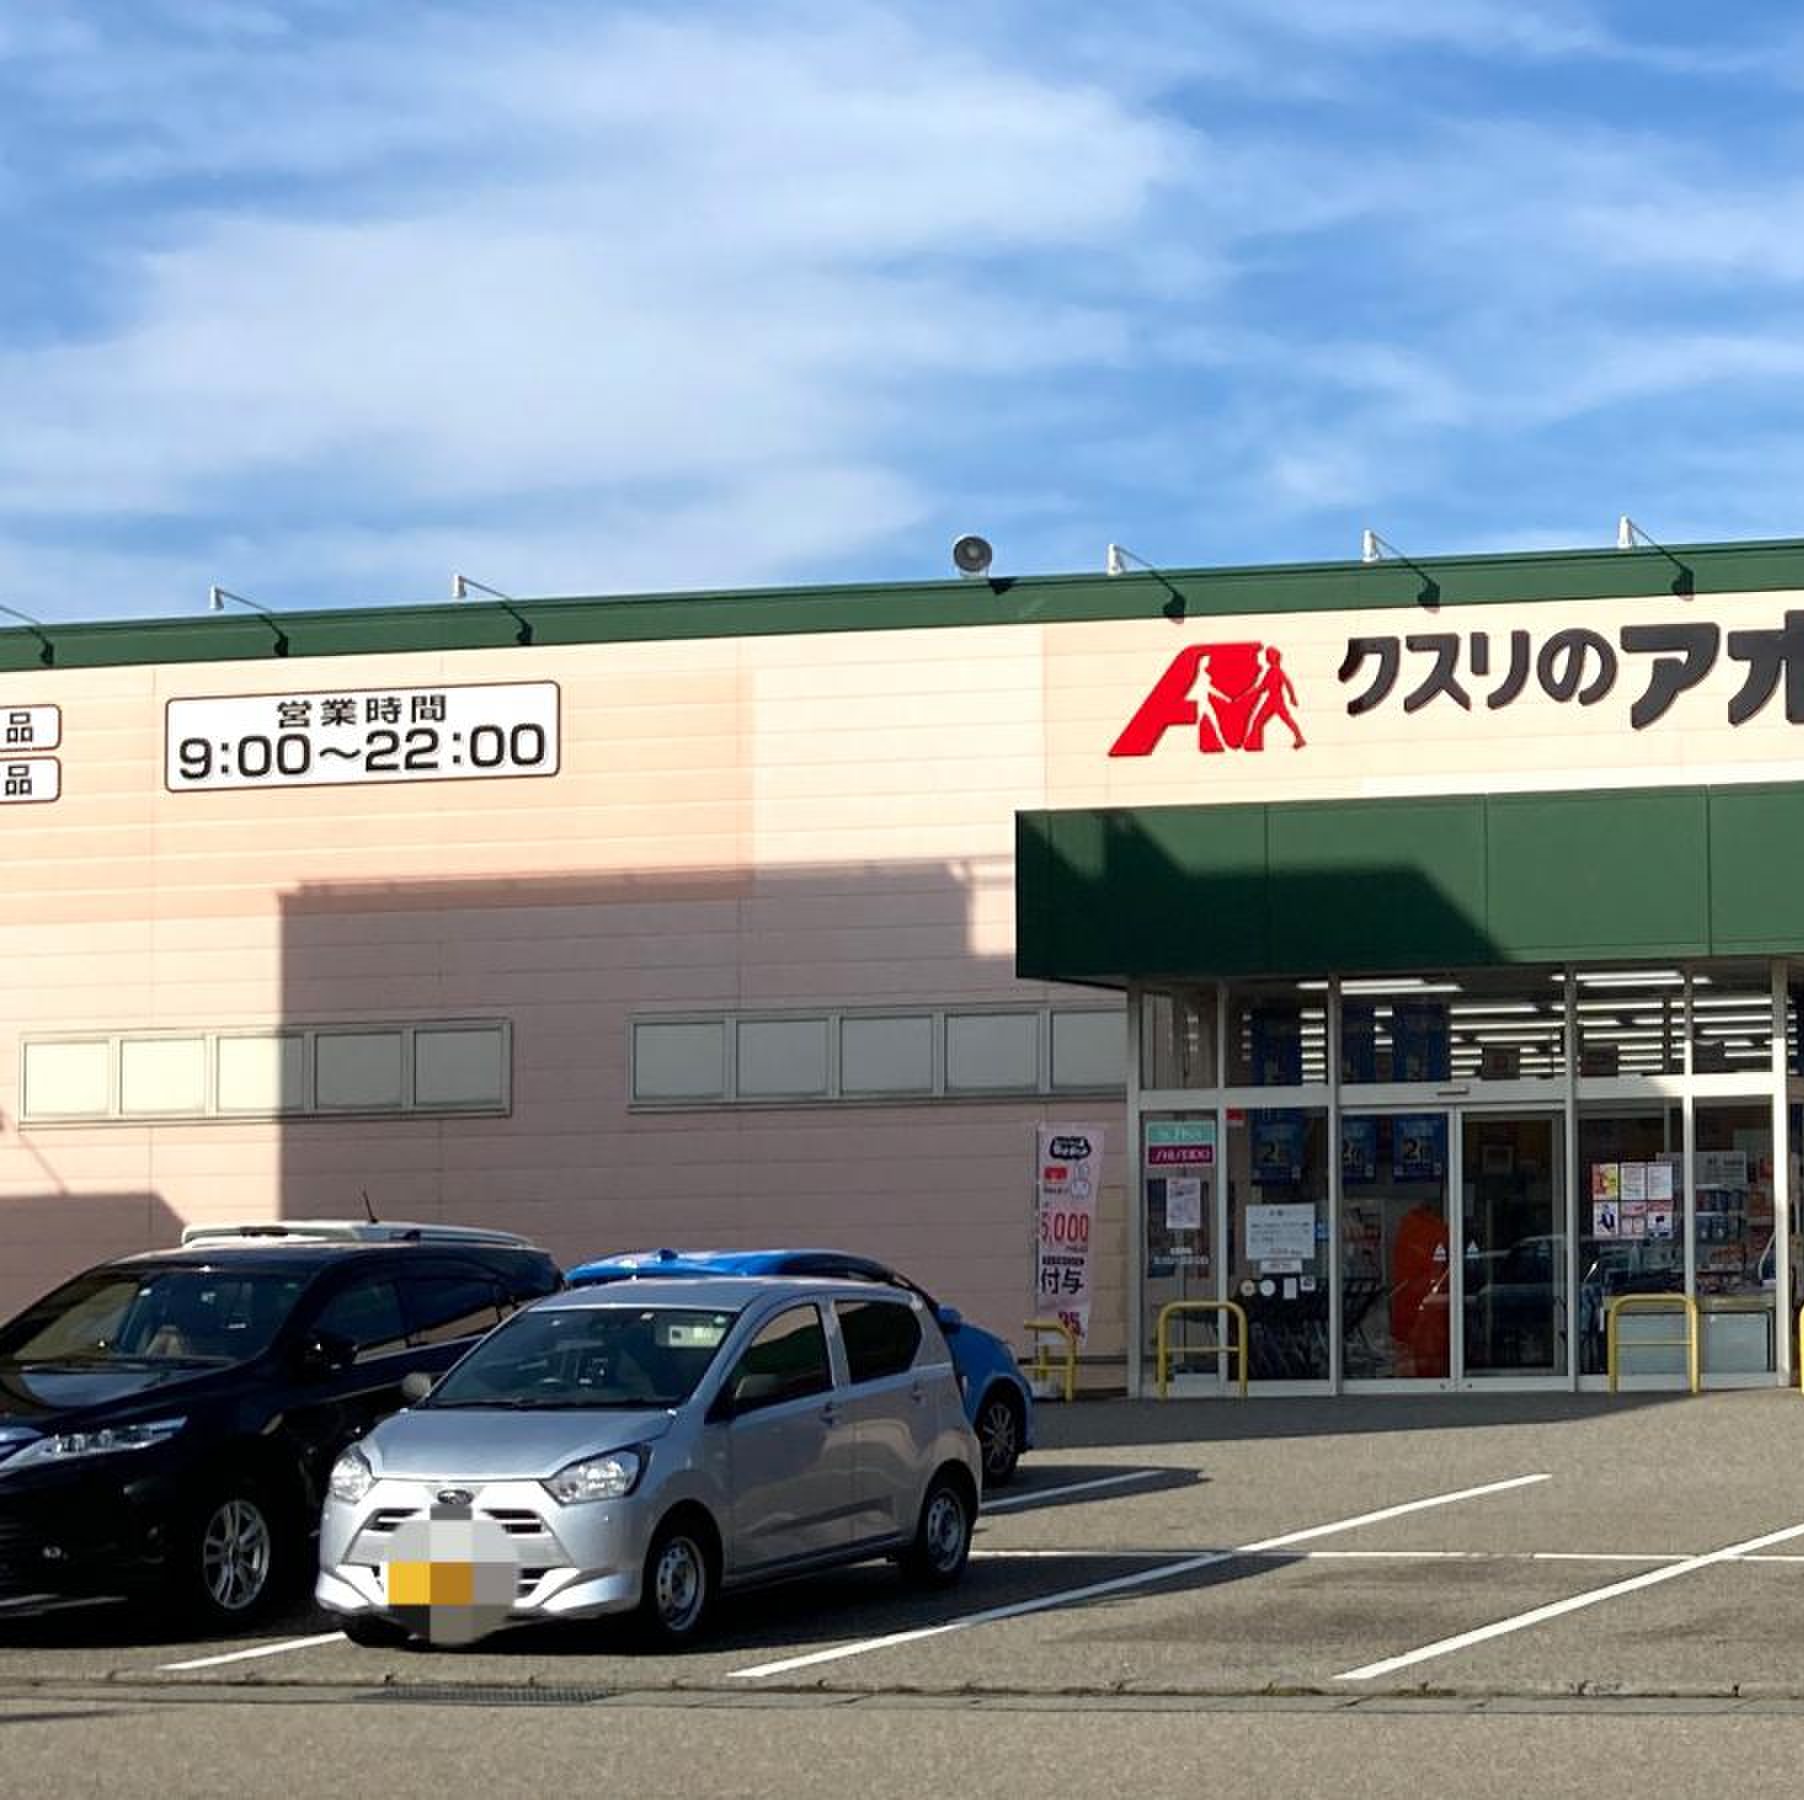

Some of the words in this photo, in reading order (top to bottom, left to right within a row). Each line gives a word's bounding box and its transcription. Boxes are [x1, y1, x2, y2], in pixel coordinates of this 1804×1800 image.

[277, 694, 447, 729] 営業時間
[6, 712, 33, 743] 品
[5, 765, 32, 796] 品
[1041, 1267, 1084, 1295] 付与
